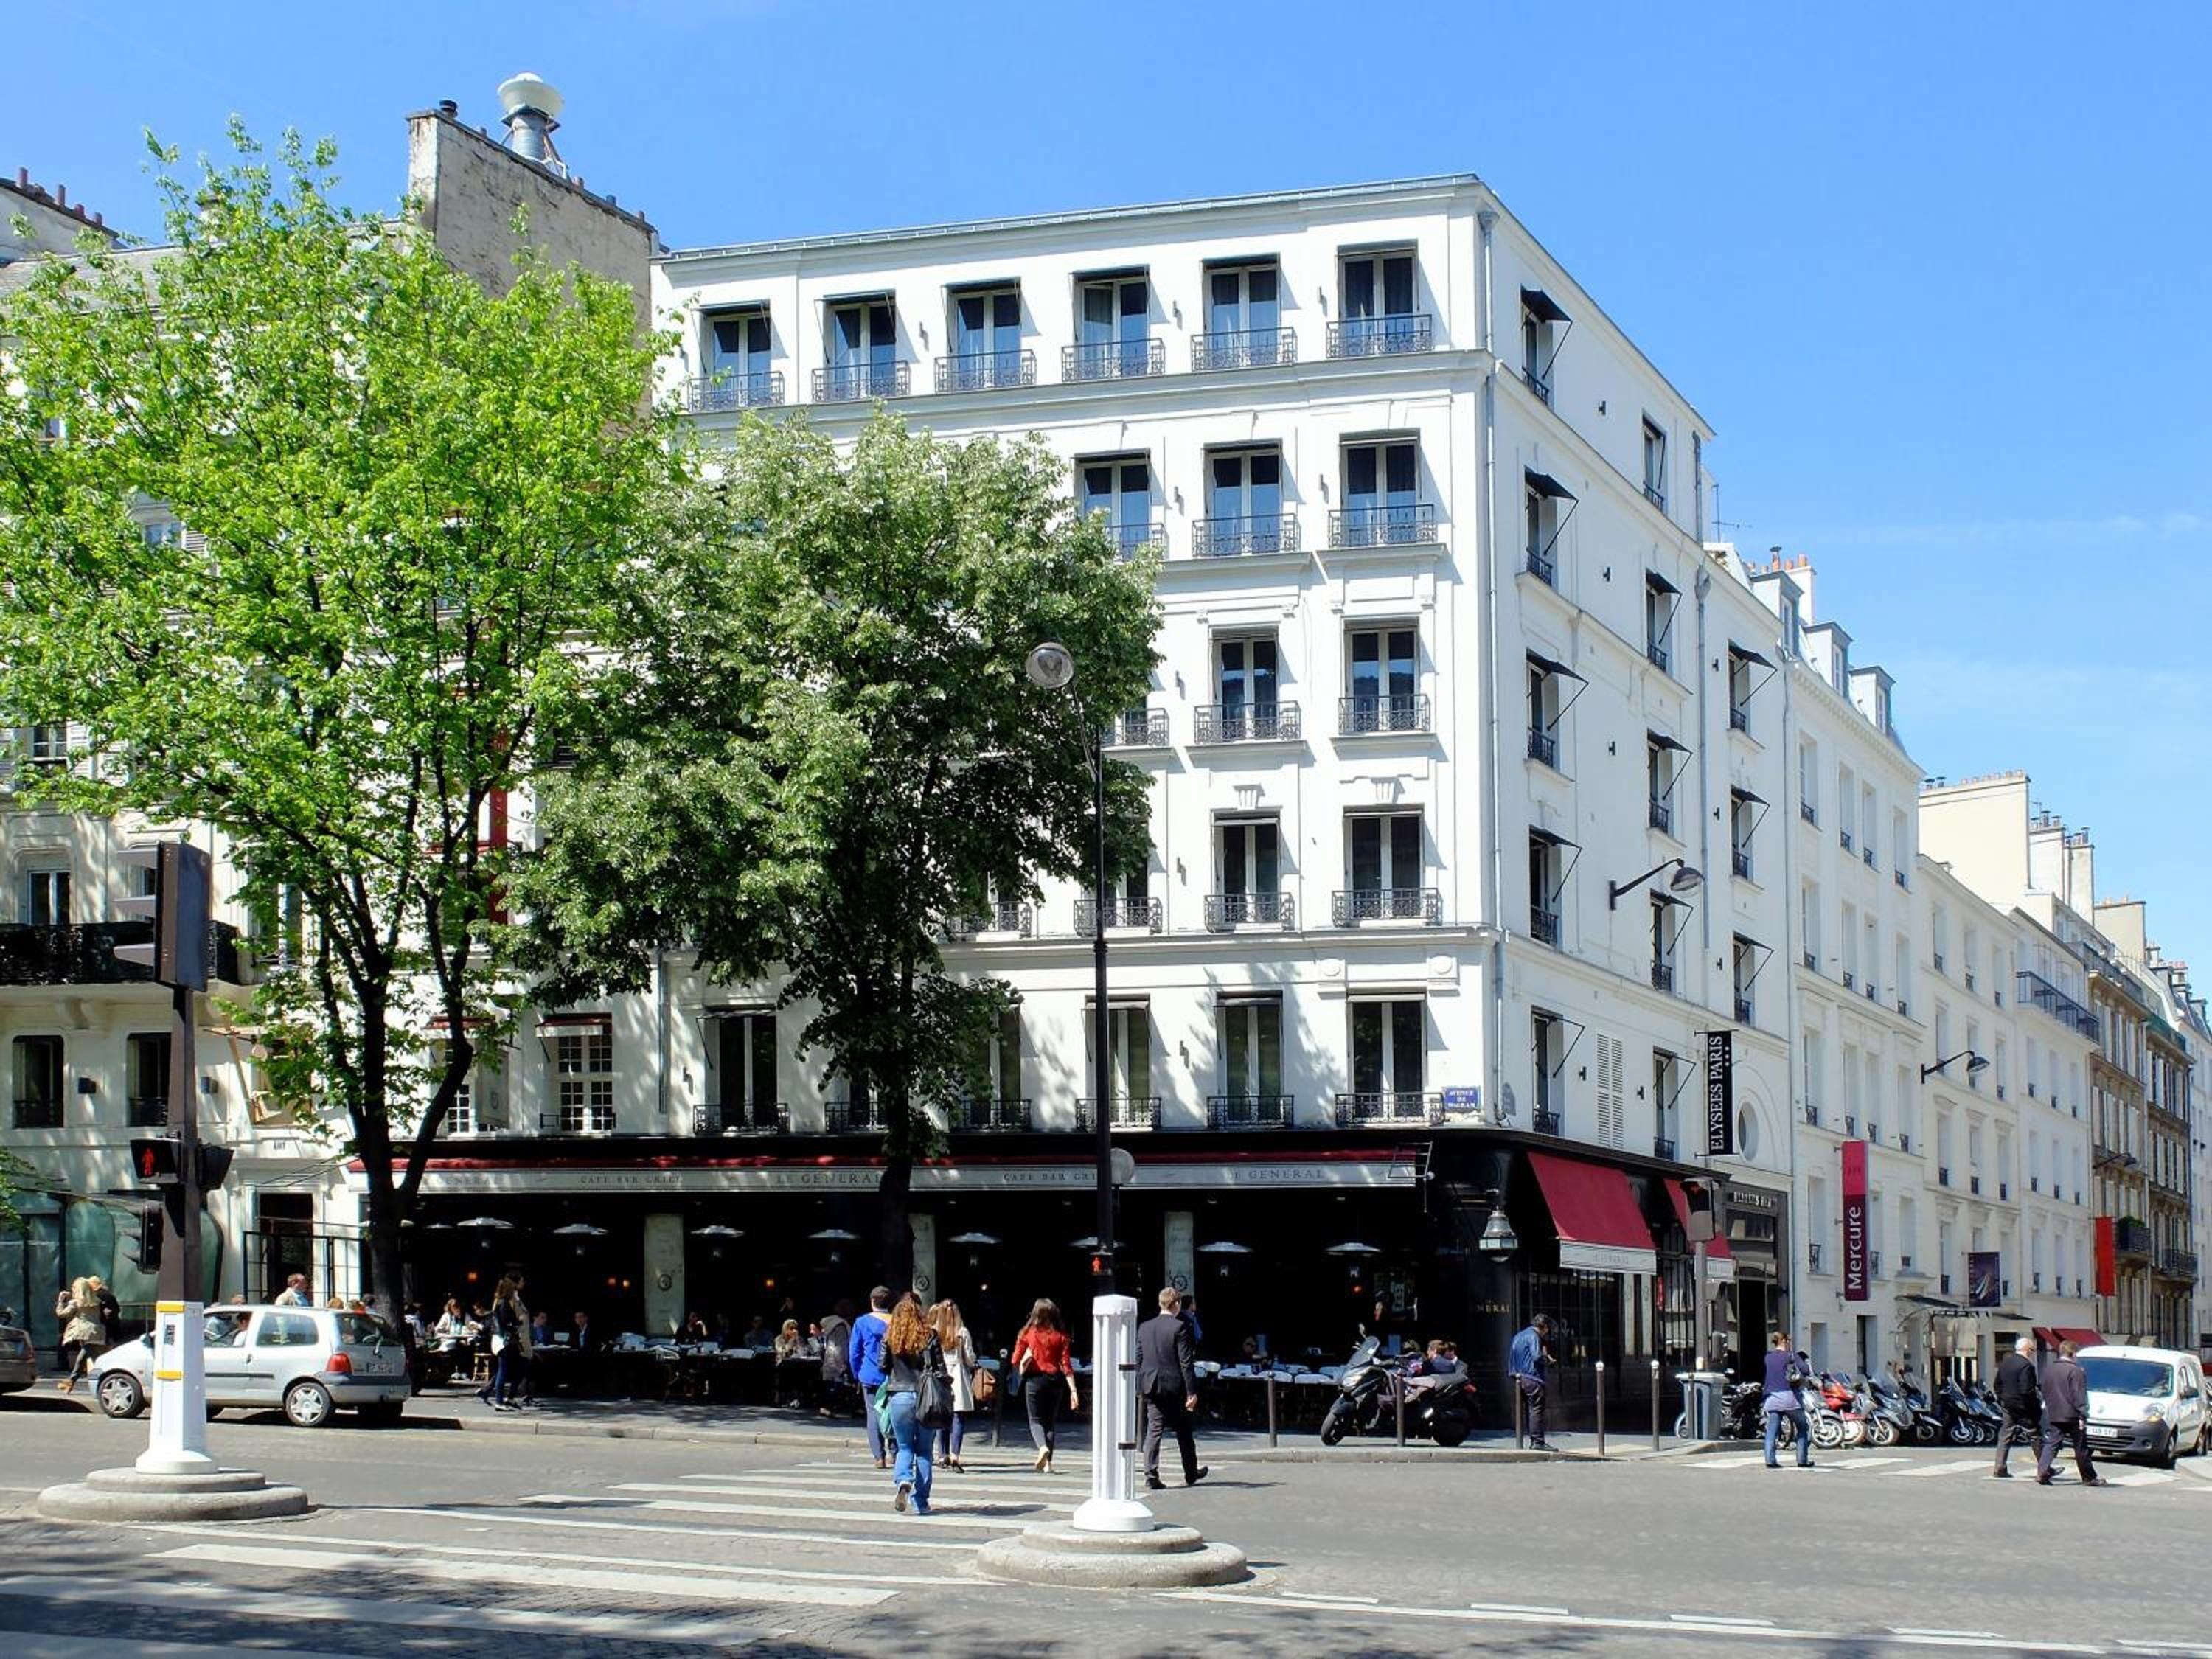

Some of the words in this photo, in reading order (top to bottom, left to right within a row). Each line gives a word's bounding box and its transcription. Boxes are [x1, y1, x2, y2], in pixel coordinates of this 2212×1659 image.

[1709, 1035, 1723, 1080] PARIS
[1710, 1083, 1724, 1150] ELYSEES
[1848, 1206, 1862, 1290] Mercure
